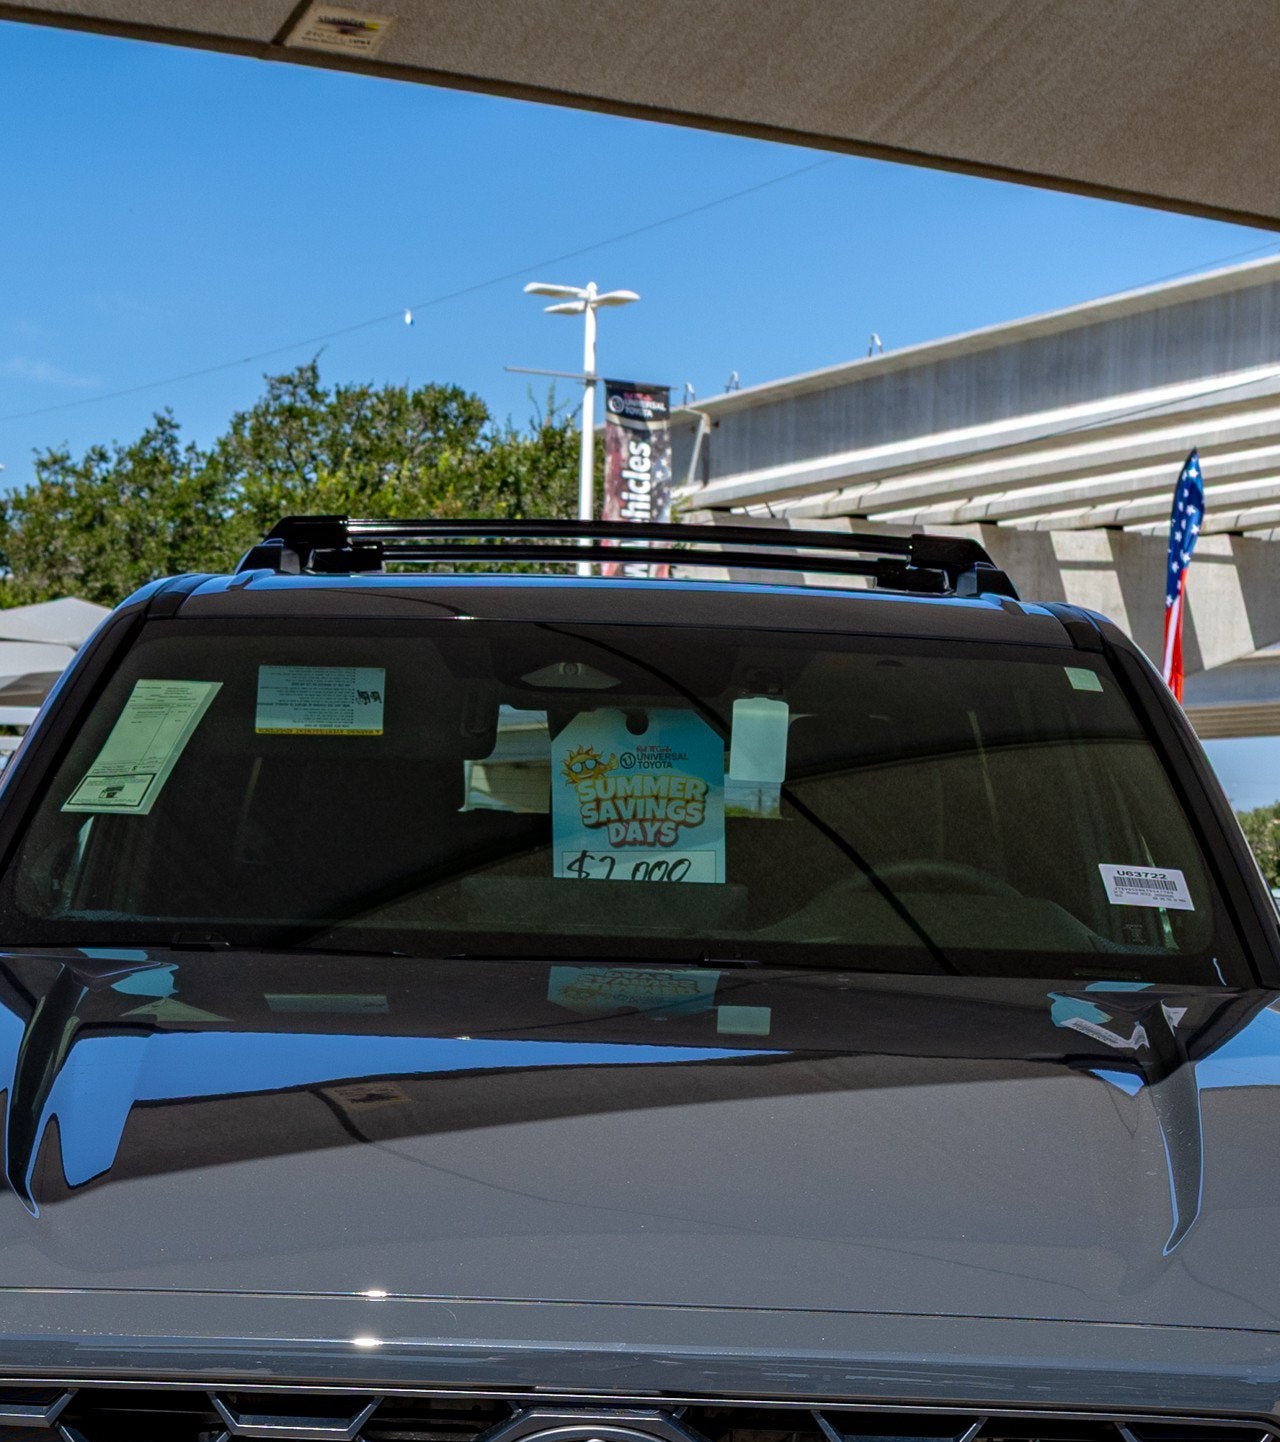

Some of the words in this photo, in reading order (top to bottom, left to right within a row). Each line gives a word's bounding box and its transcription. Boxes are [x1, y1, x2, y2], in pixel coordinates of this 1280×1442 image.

[637, 752, 688, 761] UNIVERSAL
[637, 760, 673, 769] TOYOTA
[577, 775, 708, 801] SUMMER
[581, 798, 704, 826] SAVINGS
[609, 820, 677, 846] DAYS
